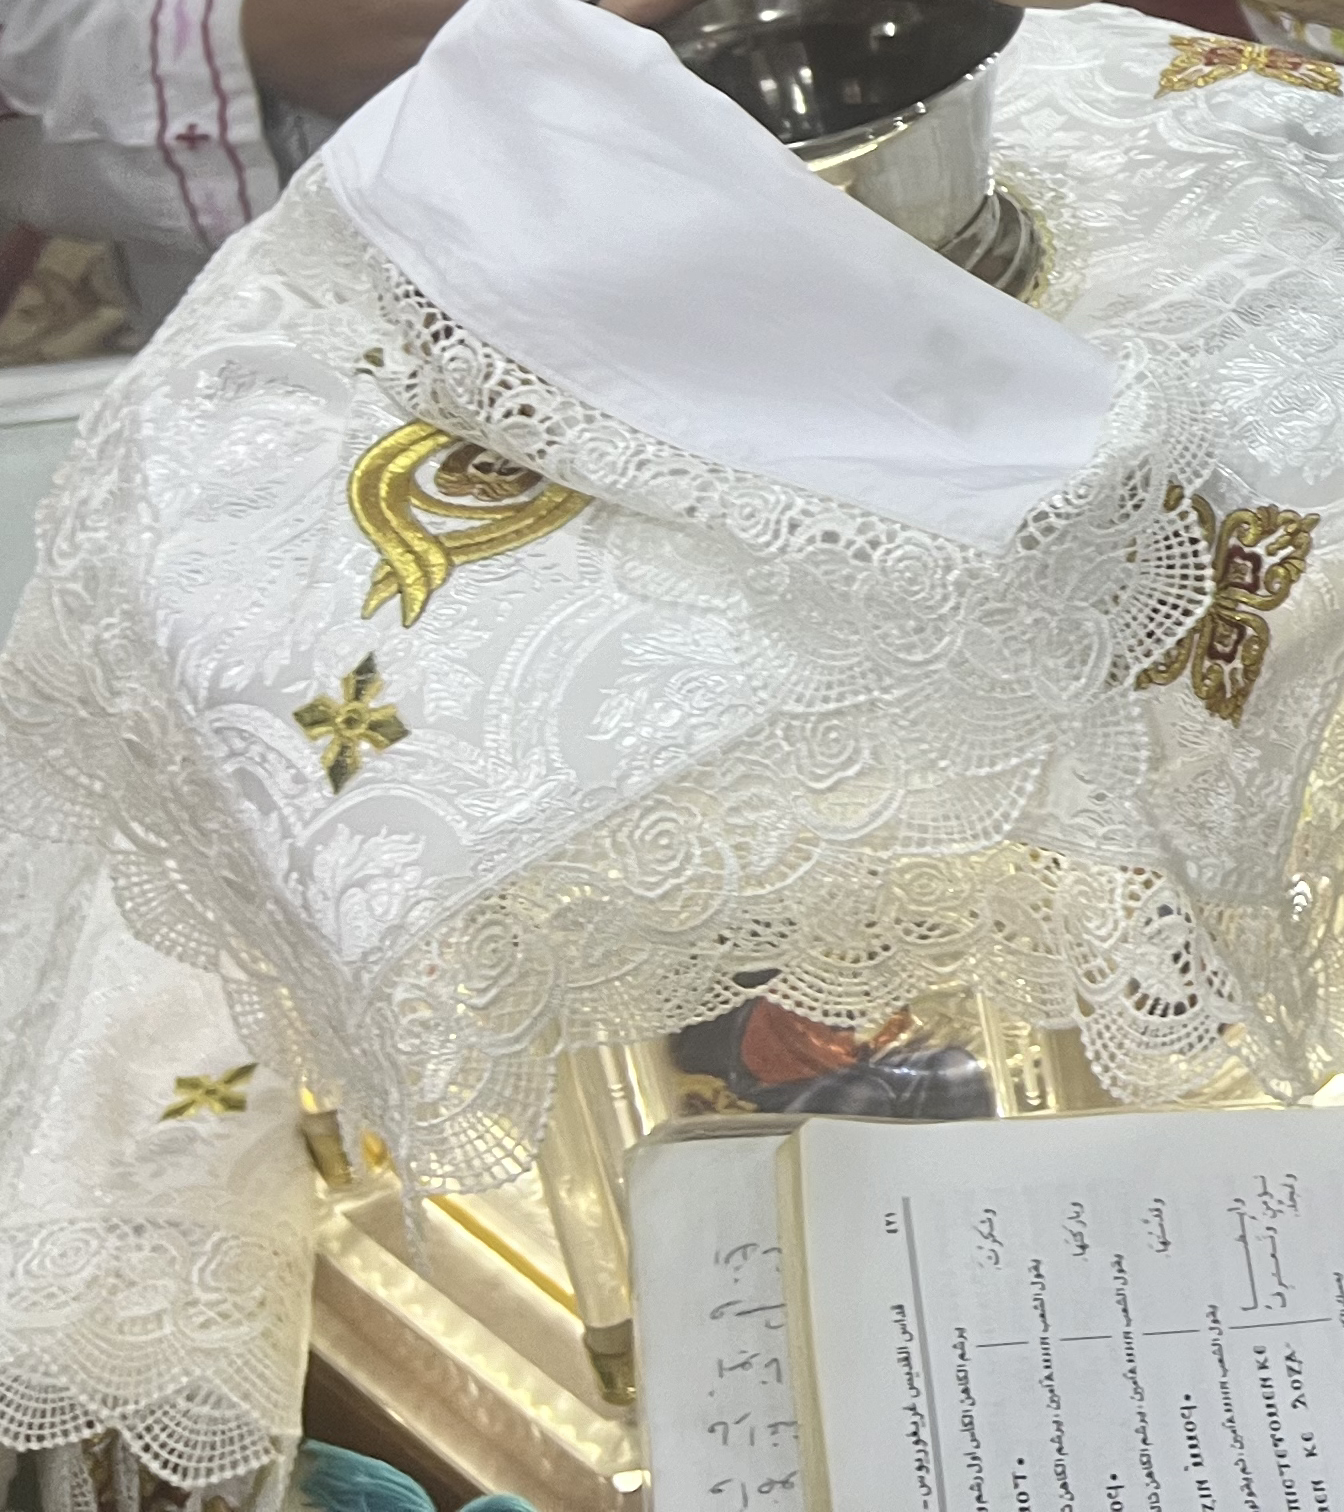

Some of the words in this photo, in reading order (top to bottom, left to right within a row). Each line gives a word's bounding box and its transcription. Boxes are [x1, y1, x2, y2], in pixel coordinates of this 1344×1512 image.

[1027, 1258, 1047, 1292] يقول
[1110, 1253, 1129, 1286] يقول
[889, 1304, 914, 1342] قداس
[1032, 1292, 1052, 1333] الشعب
[1115, 1287, 1133, 1328] الشعب
[1205, 1304, 1224, 1336] يقول
[951, 1327, 971, 1362] يرشم
[1211, 1338, 1229, 1378] الشعب
[896, 1346, 920, 1399] القديس
[955, 1364, 977, 1407] الكاهن
[1049, 1419, 1069, 1456] يرشم
[1134, 1410, 1155, 1447] يرشم
[901, 1402, 932, 1497] غريغوريوس
[1138, 1448, 1162, 1490] الكاهن
[1053, 1458, 1075, 1502] الكاهن
